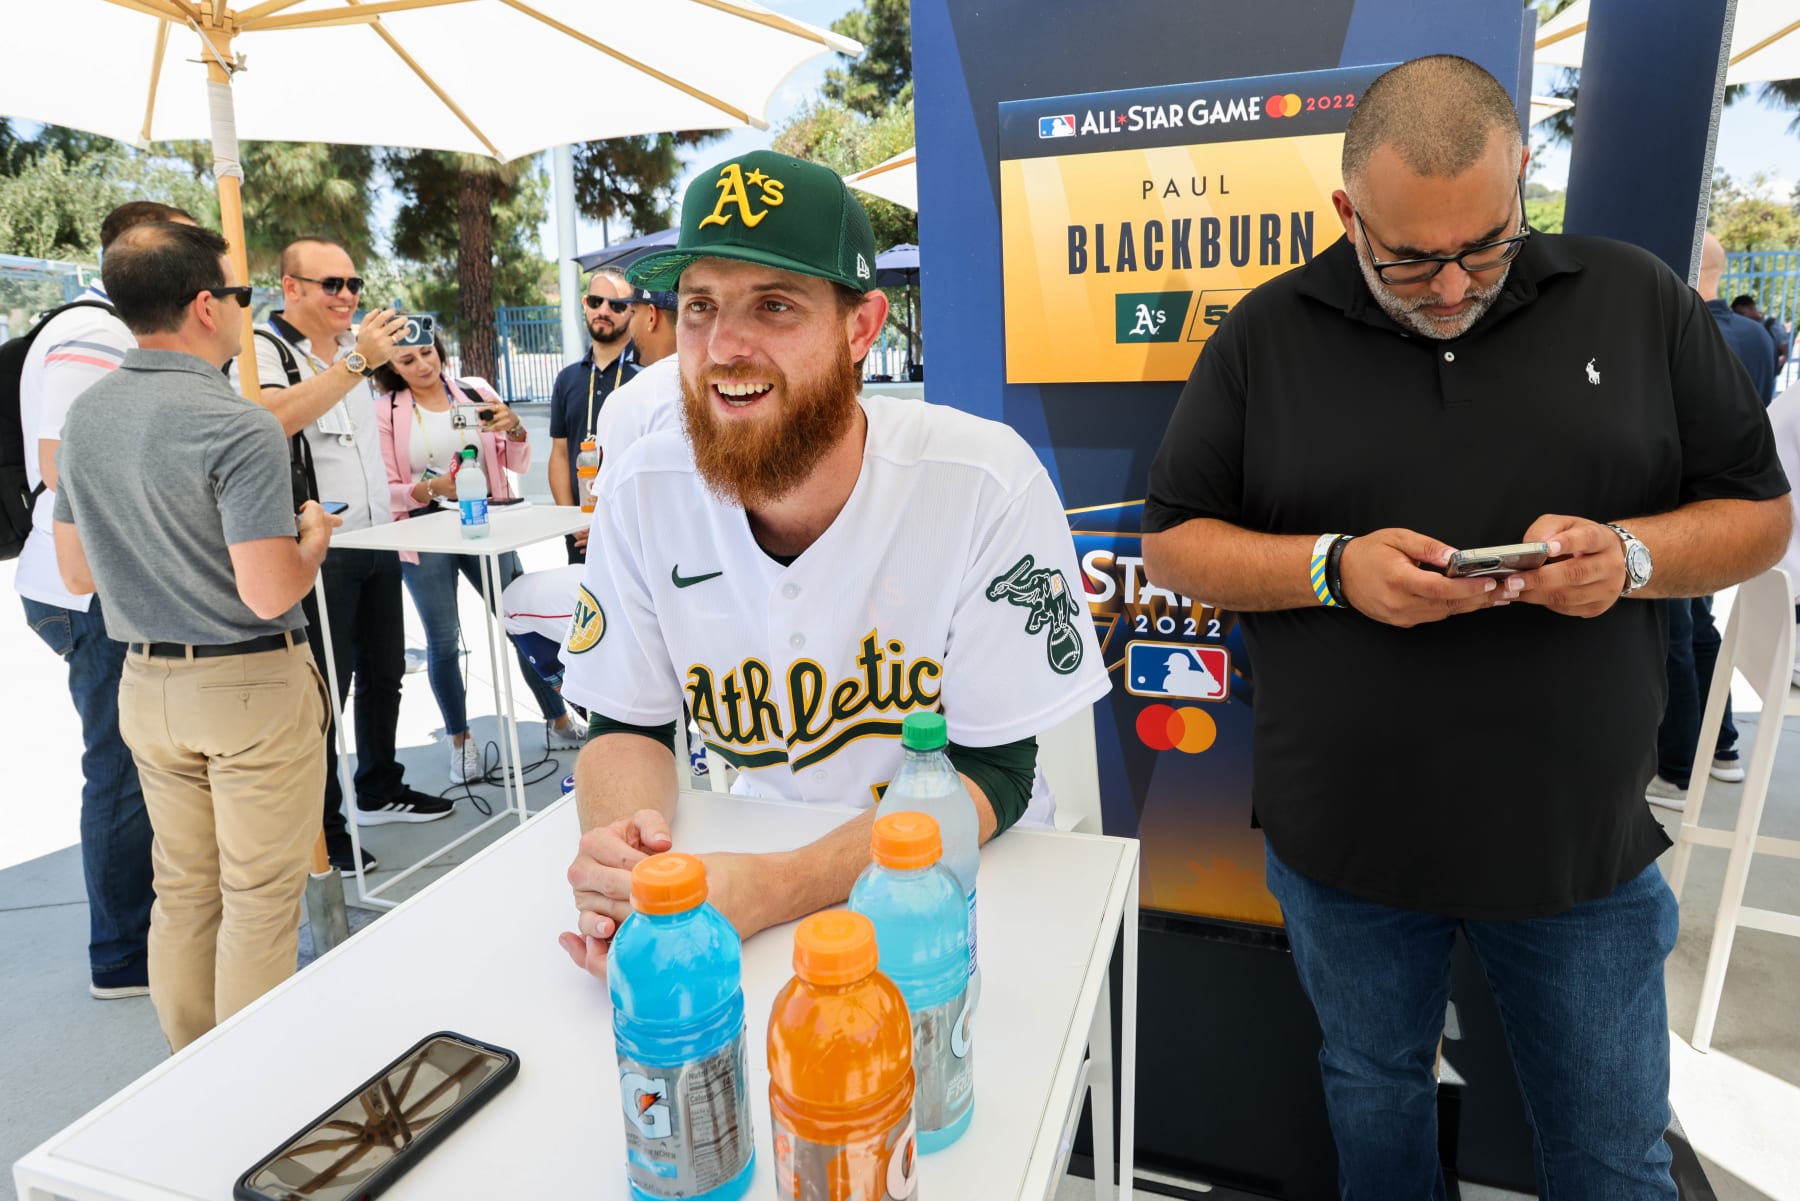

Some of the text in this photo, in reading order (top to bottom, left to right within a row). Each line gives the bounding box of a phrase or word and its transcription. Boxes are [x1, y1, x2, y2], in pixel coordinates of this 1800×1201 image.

[1187, 96, 1261, 126] GAME
[1306, 94, 1356, 112] 2022
[1142, 174, 1231, 200] PAUL
[1067, 210, 1315, 275] BLACKBURN
[1135, 614, 1221, 638] 2022
